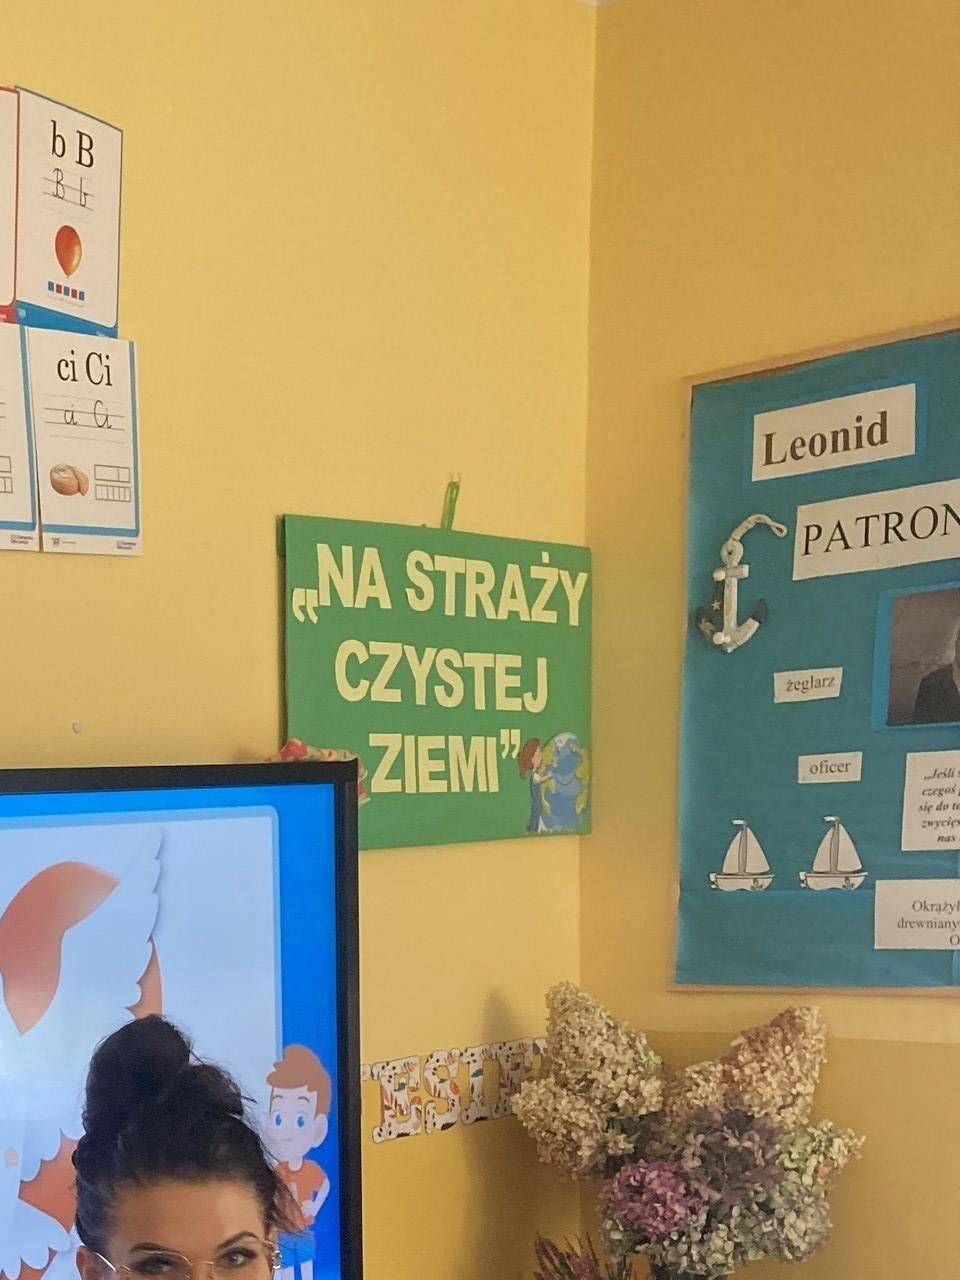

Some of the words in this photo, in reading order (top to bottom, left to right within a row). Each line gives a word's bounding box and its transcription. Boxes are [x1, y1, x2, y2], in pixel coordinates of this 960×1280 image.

[57, 349, 78, 382] ci
[85, 351, 113, 387] Ci
[762, 410, 890, 467] Leonid
[405, 549, 589, 627] STRAŻY
[334, 638, 549, 714] CZYSTEJ
[785, 674, 836, 695] żeglarz
[809, 759, 852, 775] oficer
[936, 800, 950, 812] do
